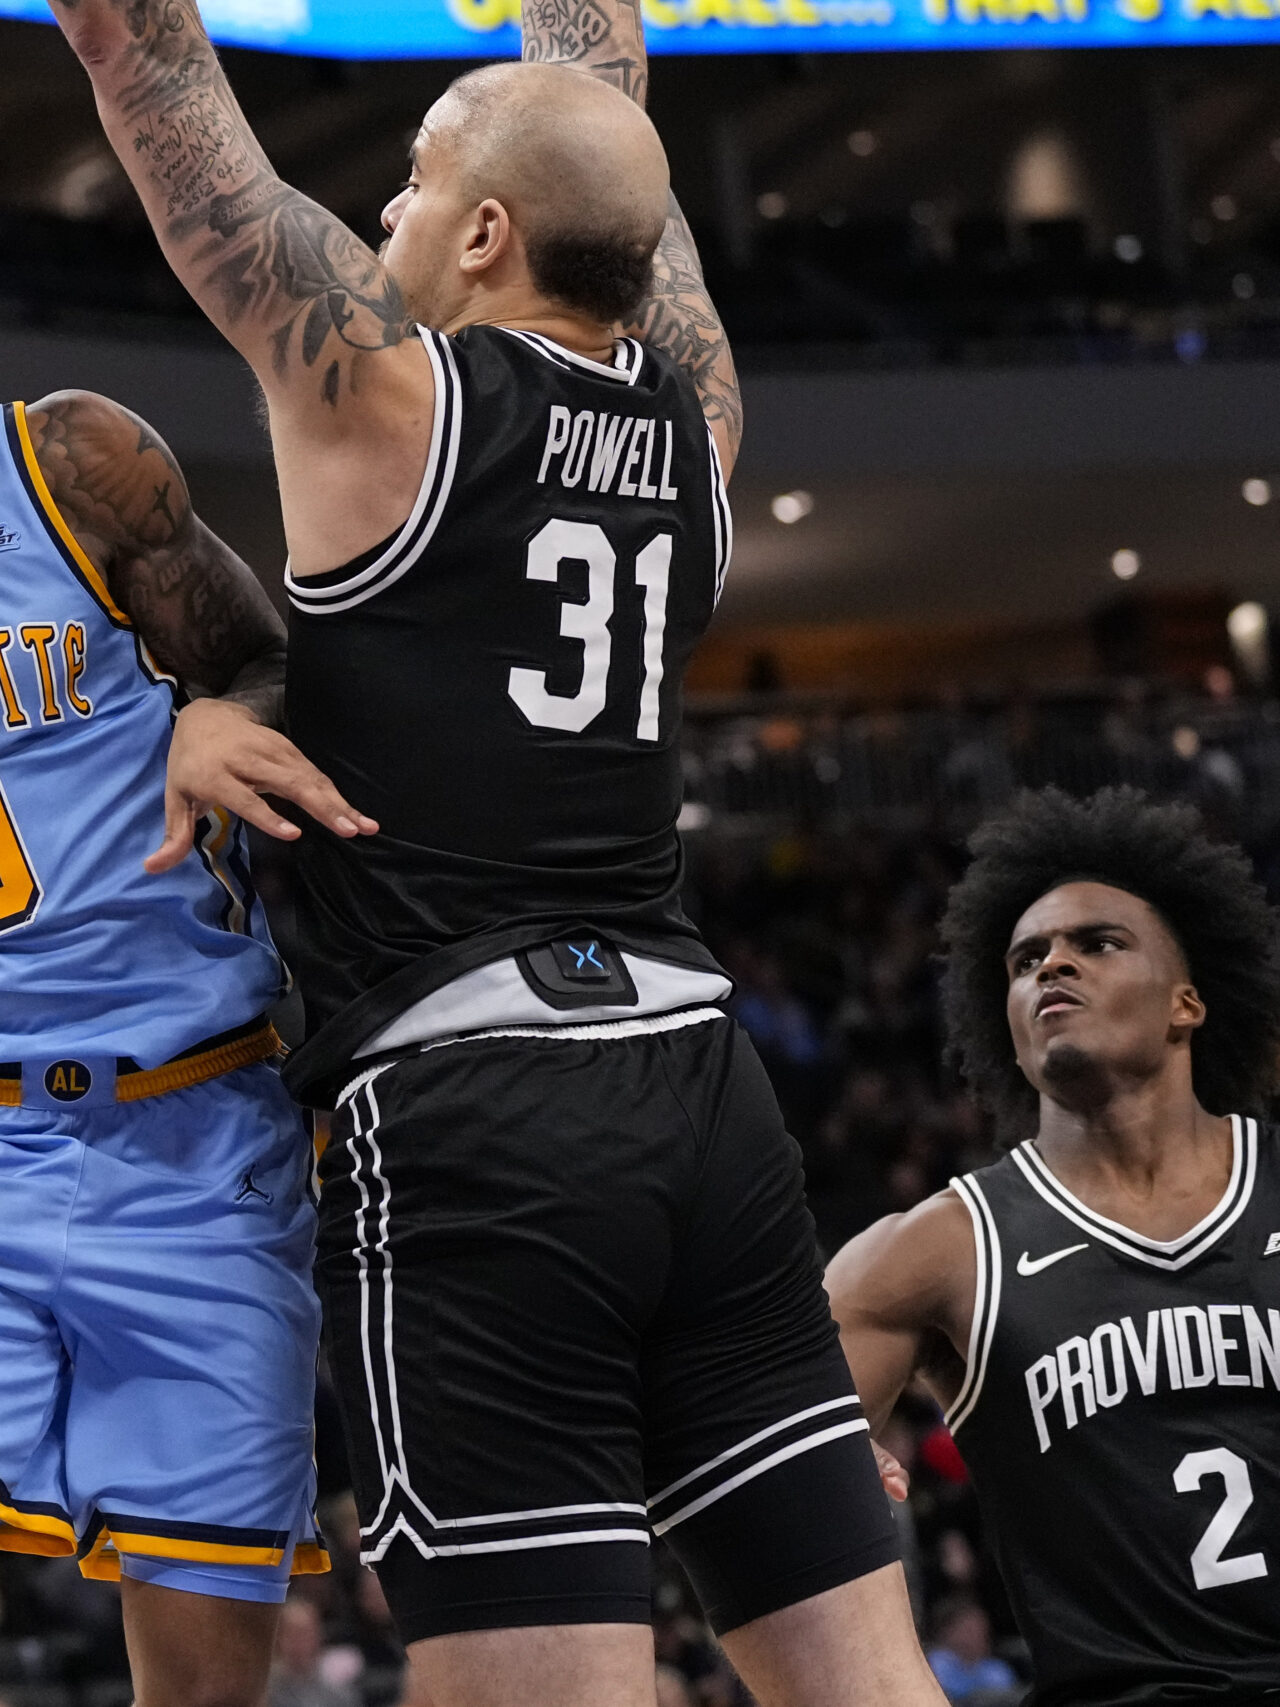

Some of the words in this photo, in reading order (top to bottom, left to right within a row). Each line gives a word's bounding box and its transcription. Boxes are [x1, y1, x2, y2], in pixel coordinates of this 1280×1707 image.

[537, 404, 677, 500] POWELL
[508, 518, 672, 741] 31
[52, 1066, 85, 1092] AL
[1024, 1304, 1280, 1454] PROVIDEN
[1172, 1447, 1268, 1590] 2
